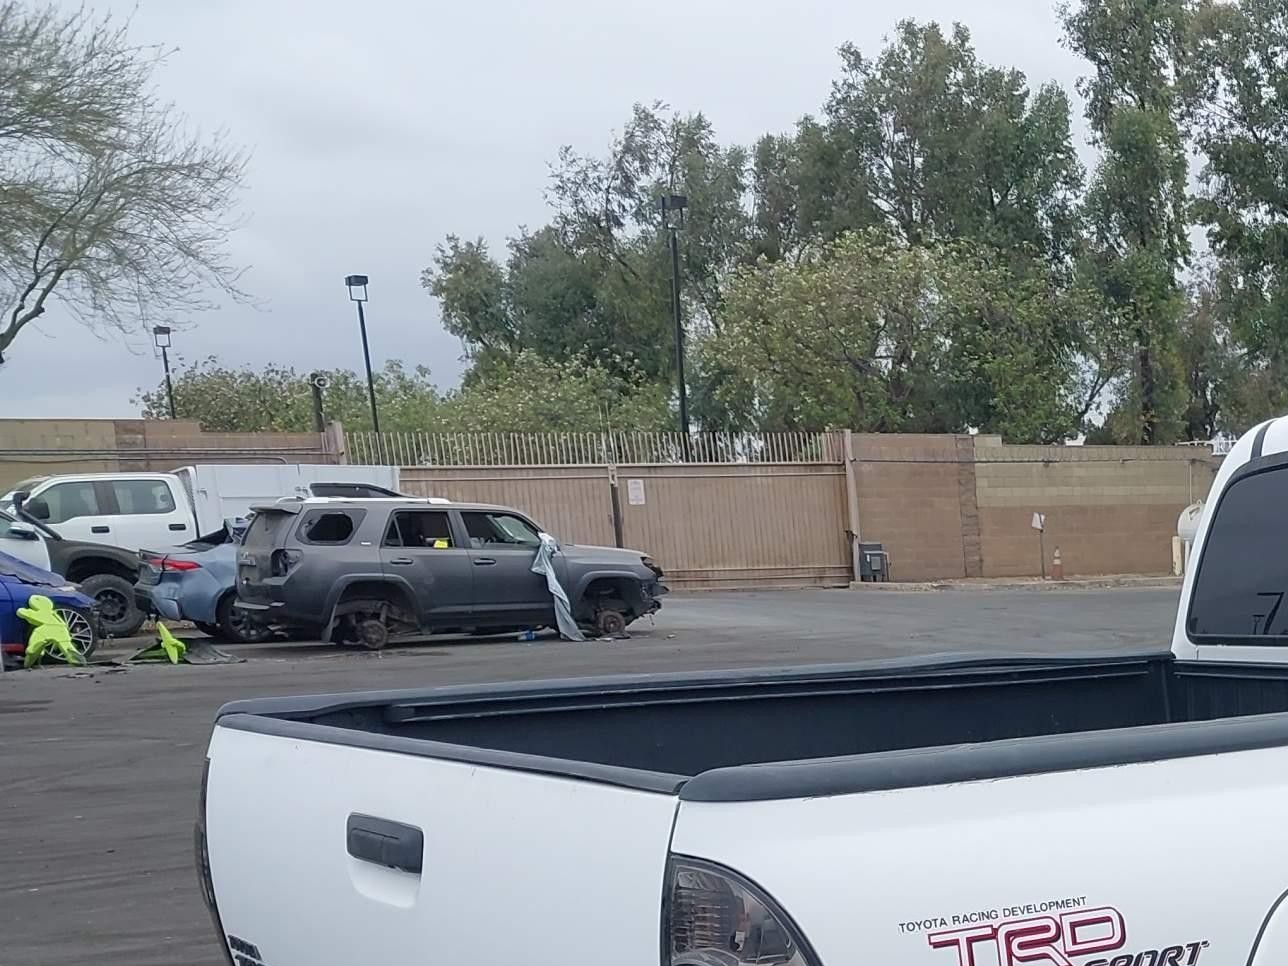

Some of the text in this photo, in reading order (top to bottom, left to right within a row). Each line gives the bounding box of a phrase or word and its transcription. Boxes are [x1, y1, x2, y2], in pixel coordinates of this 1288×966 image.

[899, 896, 1087, 933] TOYOTA RACING DEVELOPMENT
